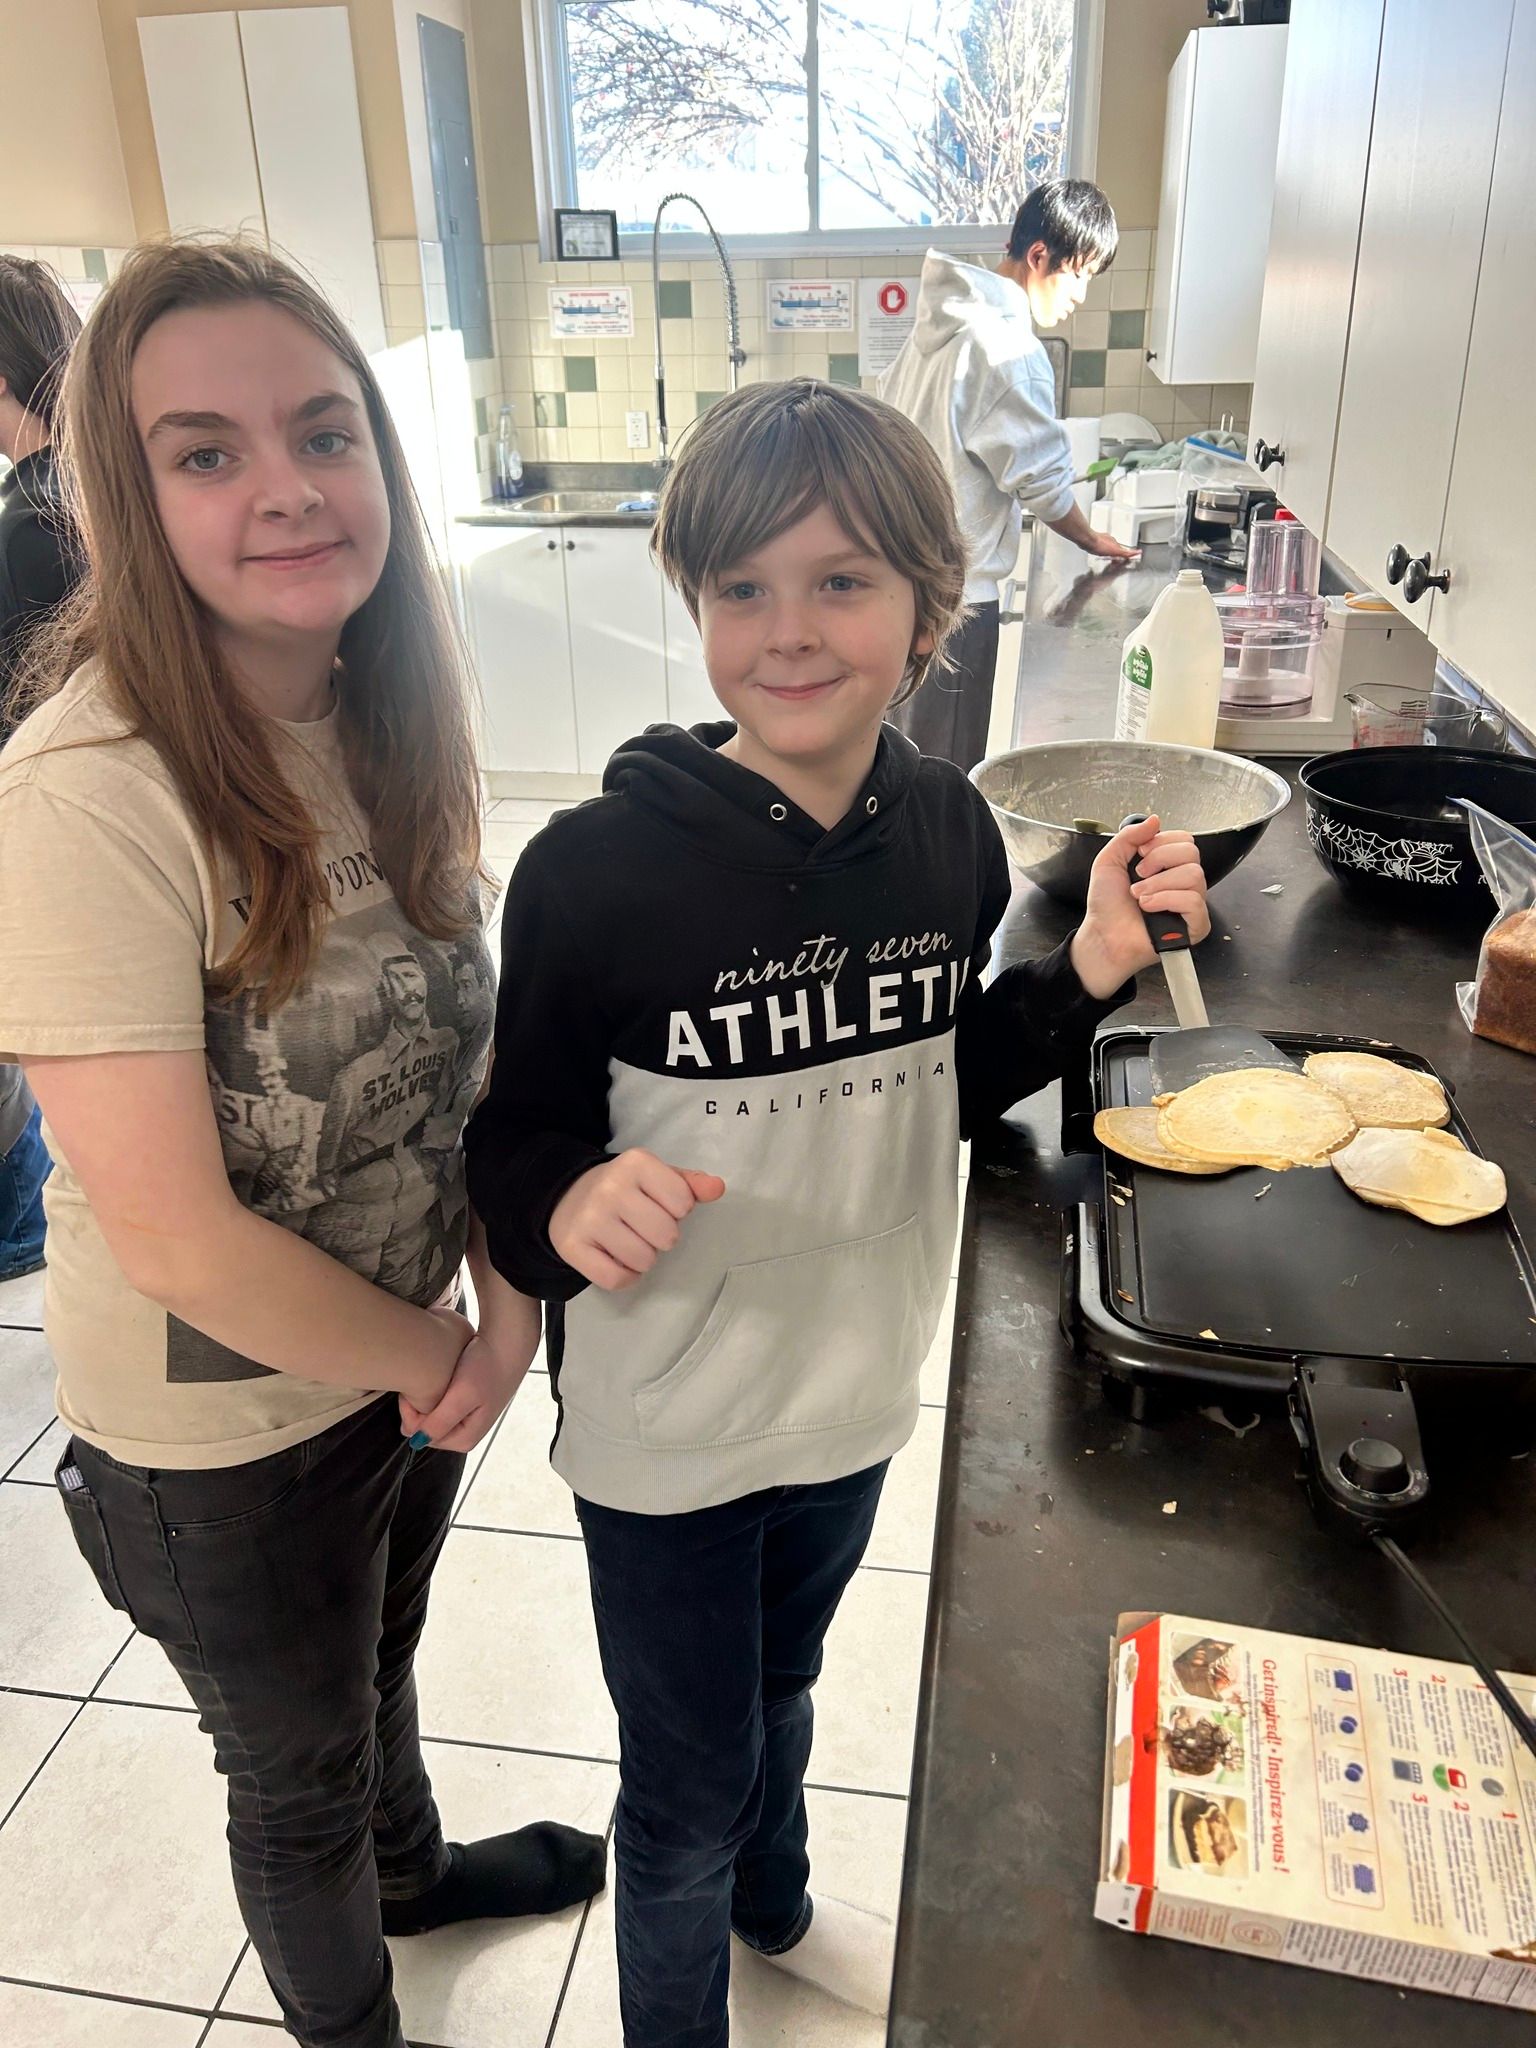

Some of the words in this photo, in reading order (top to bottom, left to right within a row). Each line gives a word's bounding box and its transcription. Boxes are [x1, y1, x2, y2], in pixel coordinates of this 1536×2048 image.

[714, 934, 849, 993] ninety
[866, 930, 953, 963] seven
[666, 956, 970, 1067] ATHLETI
[363, 1072, 395, 1102] ST.
[400, 1051, 446, 1081] LOUIS
[705, 1062, 945, 1115] CALIFORNIA
[1263, 1659, 1277, 1683] Get
[1393, 1668, 1408, 1677] 3
[1431, 1675, 1446, 1684] 2
[1261, 1684, 1282, 1749] inspired!
[1412, 1792, 1428, 1804] 3
[1453, 1800, 1470, 1812] 2
[1502, 1811, 1517, 1819] 1
